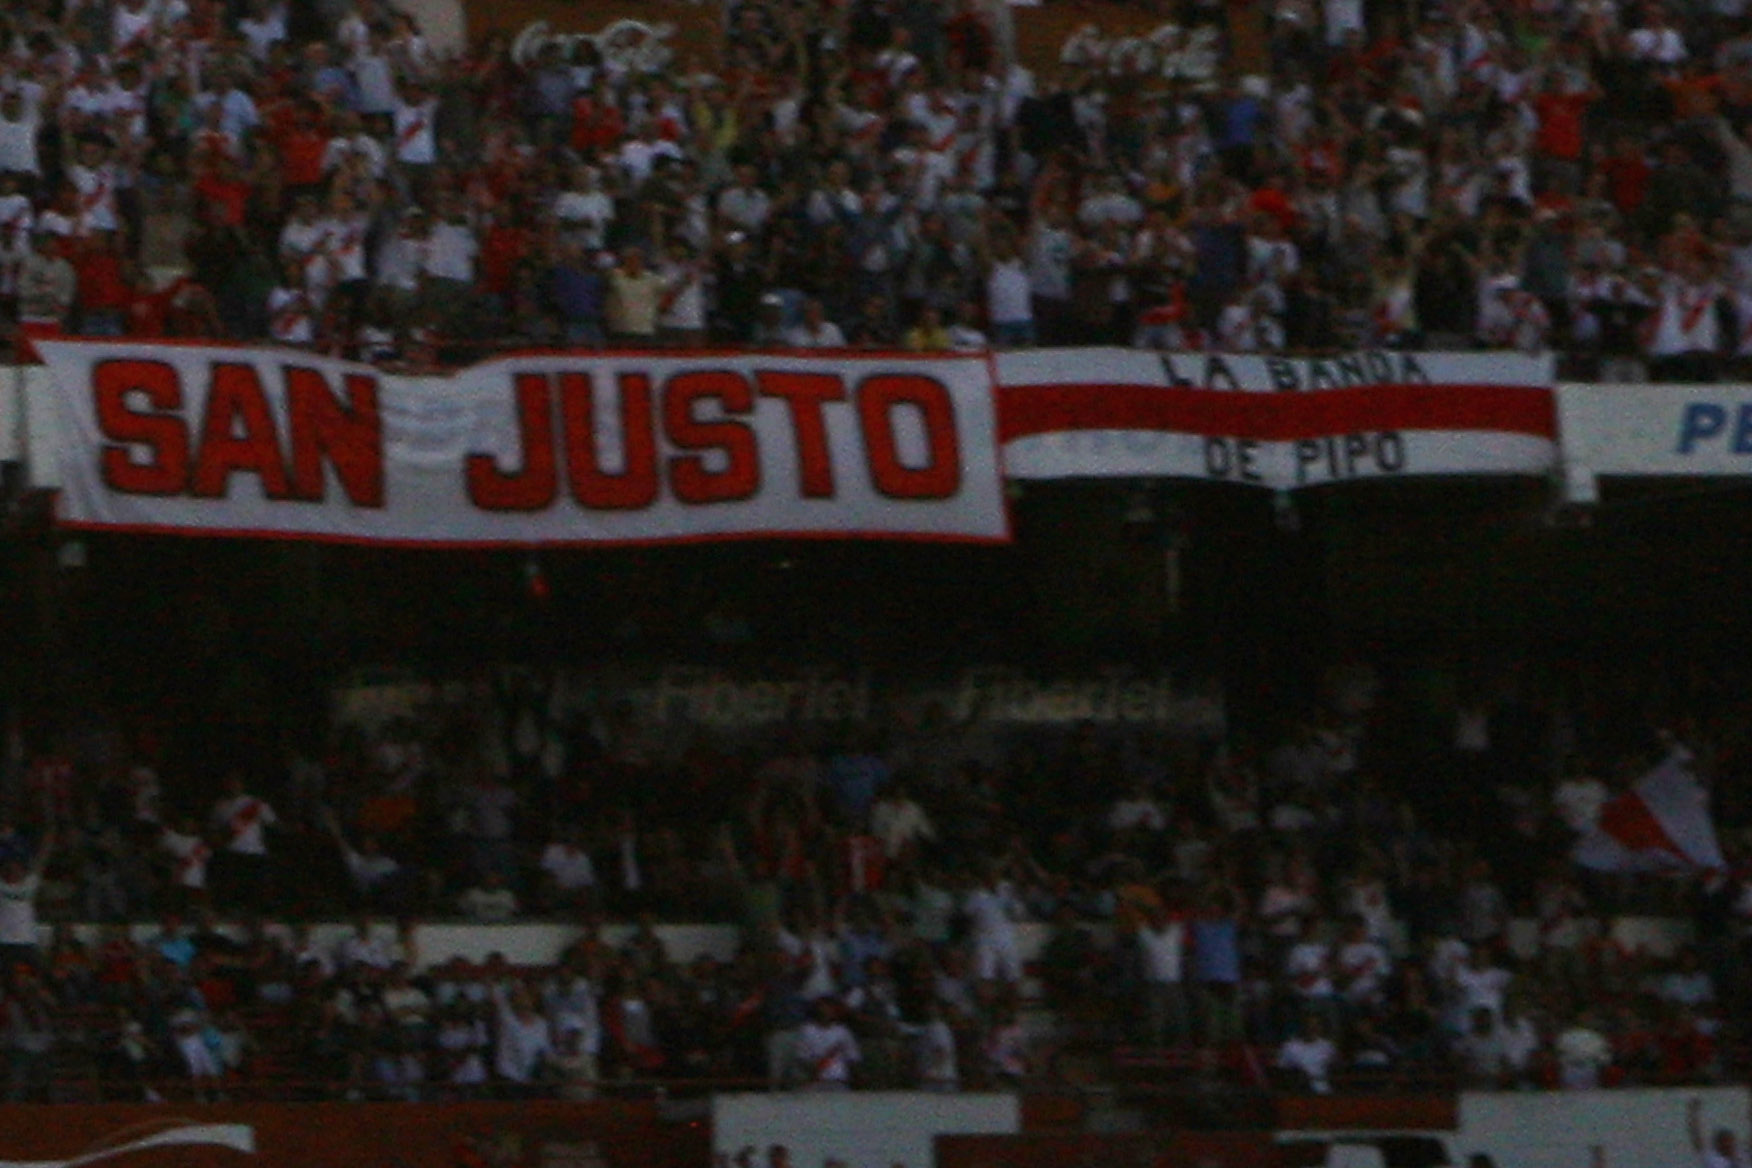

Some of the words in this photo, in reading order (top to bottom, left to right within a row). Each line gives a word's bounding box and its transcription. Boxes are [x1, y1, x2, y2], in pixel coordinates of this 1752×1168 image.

[1161, 354, 1238, 389] LA
[91, 357, 384, 508] SAN
[464, 368, 959, 513] JUSTO
[1207, 435, 1261, 482] DE
[1296, 432, 1405, 483] PIPO
